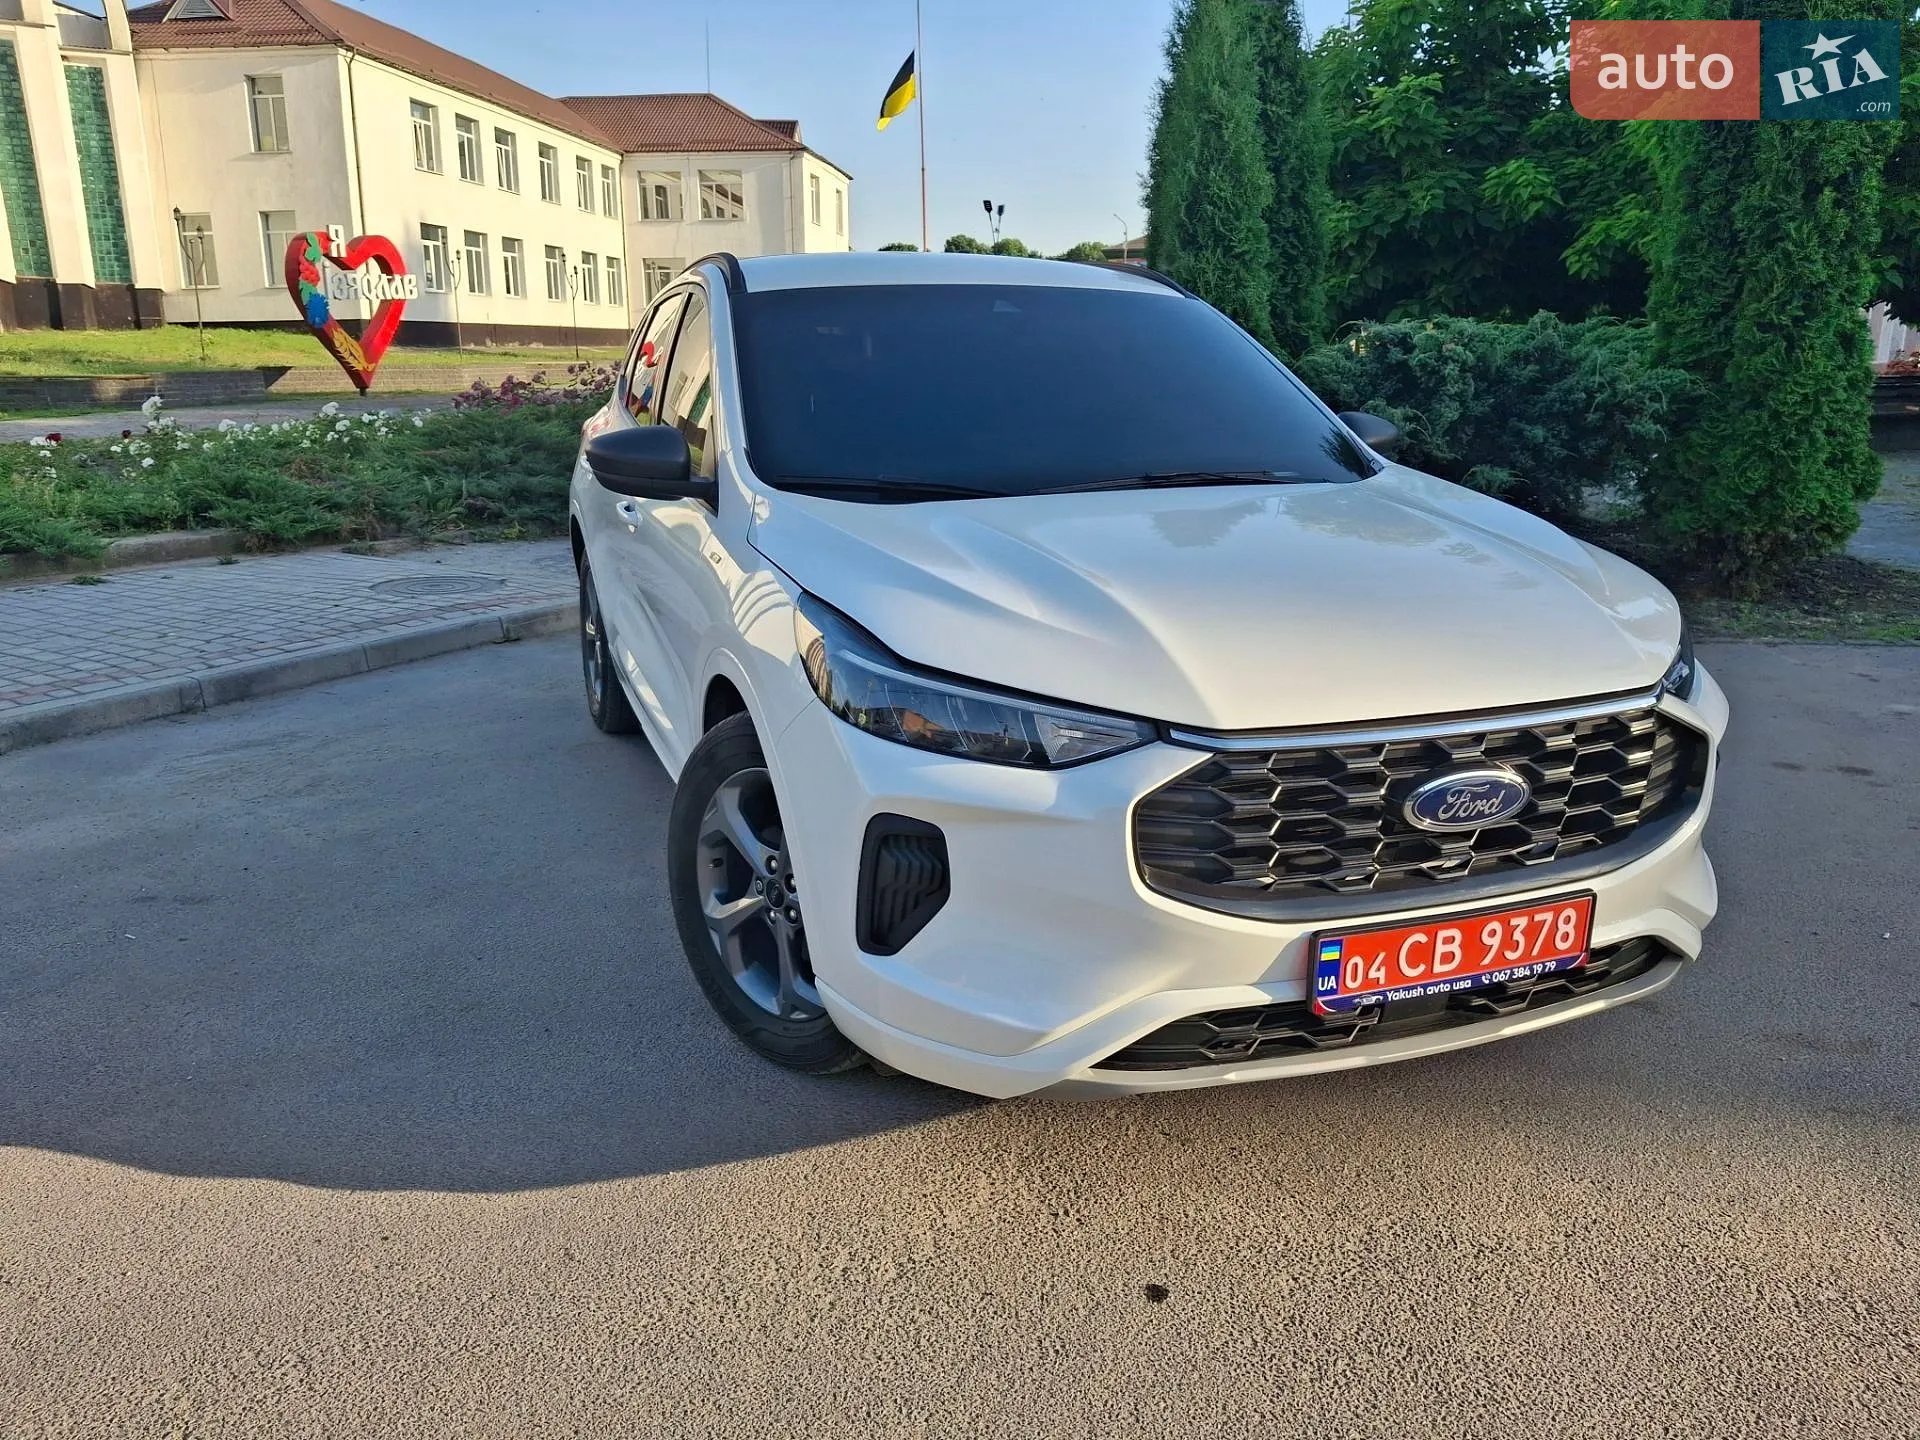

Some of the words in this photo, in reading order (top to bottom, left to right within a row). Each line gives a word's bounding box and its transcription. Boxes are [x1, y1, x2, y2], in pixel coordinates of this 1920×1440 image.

[327, 224, 346, 258] Я
[1438, 784, 1506, 820] Ford
[1344, 951, 1386, 989] 04
[1398, 927, 1463, 978] CB
[1479, 907, 1577, 966] 9378
[1318, 975, 1337, 991] UA
[1491, 969, 1511, 983] 067
[1512, 966, 1531, 980] 384
[1532, 963, 1542, 976] 19
[1542, 960, 1557, 973] 79
[1386, 986, 1424, 1002] Yakush
[1426, 982, 1451, 996] avto
[1452, 978, 1472, 991] usa
